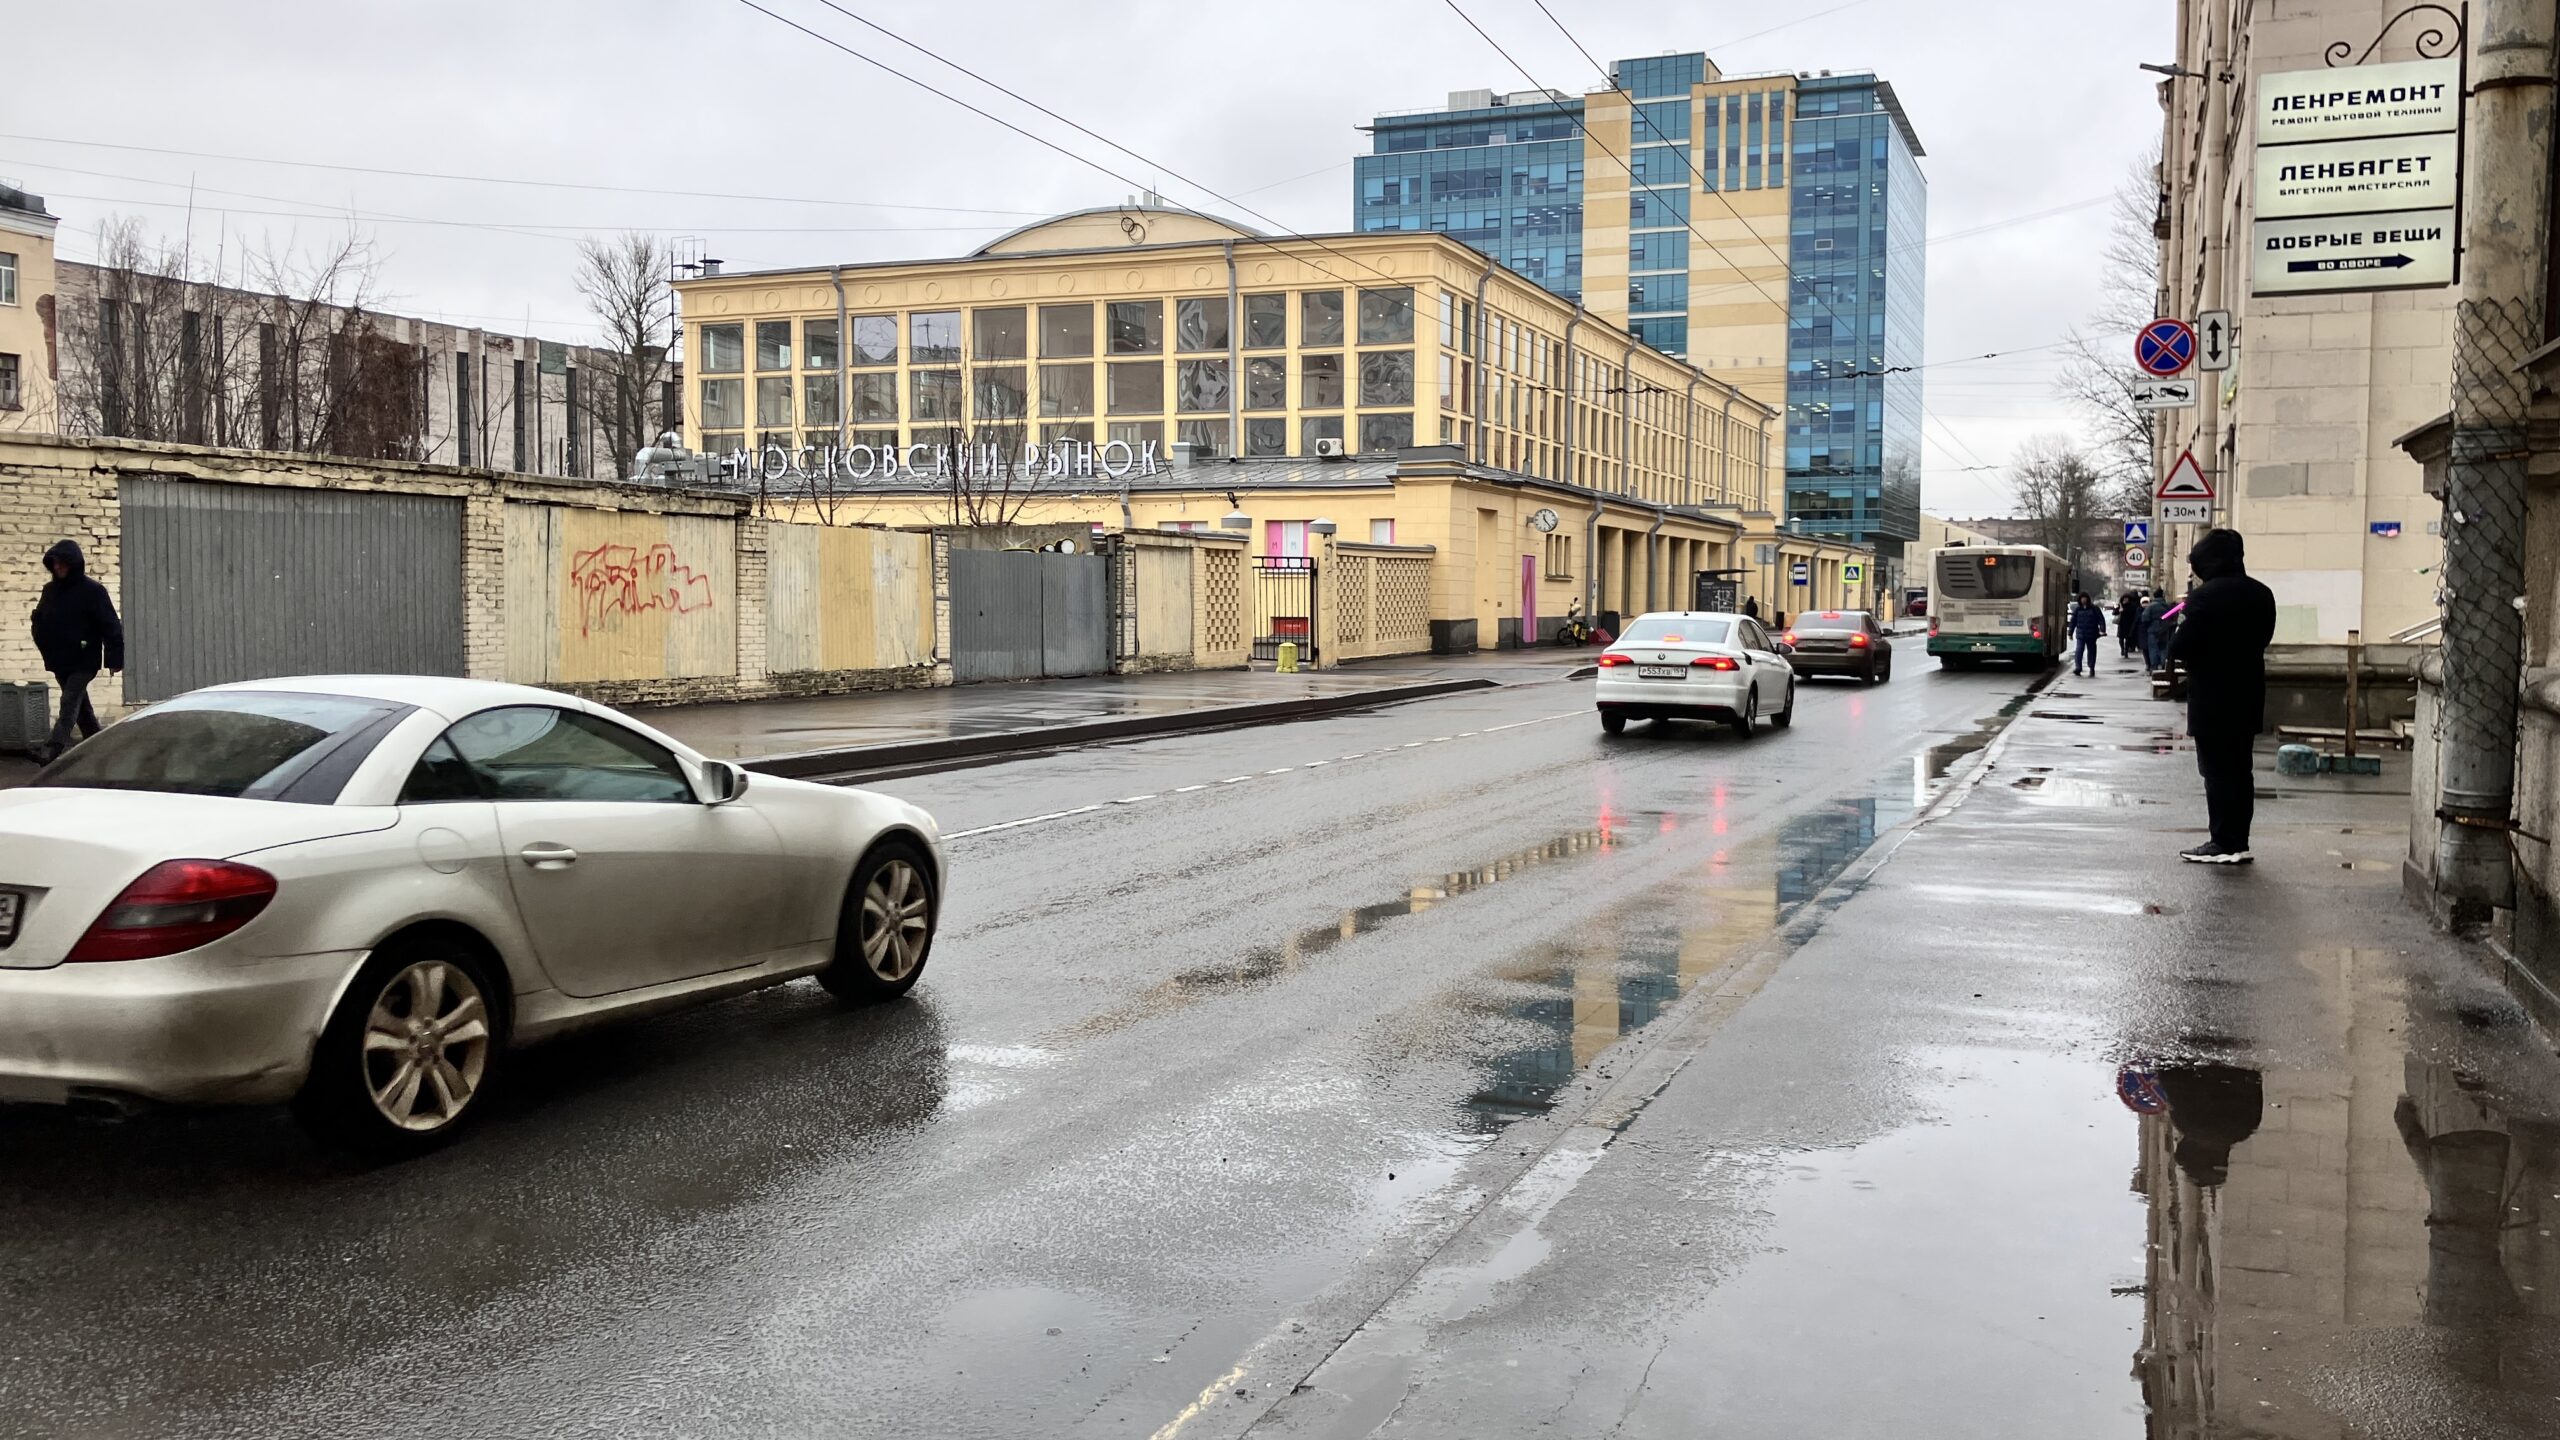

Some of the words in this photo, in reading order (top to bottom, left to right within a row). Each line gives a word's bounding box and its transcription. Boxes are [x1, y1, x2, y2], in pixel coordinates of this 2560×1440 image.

[2272, 84, 2445, 111] ЛЕНРЕМОНТ
[2272, 116, 2319, 126] РЕМОНТ
[2324, 111, 2381, 121] БЫТОВОЙ
[2387, 106, 2442, 117] ТЕХНИКИ
[2279, 156, 2431, 181] ЛЕНБАГЕТ
[2279, 185, 2342, 196] БАГЕТНАЯ
[2347, 179, 2430, 191] МАСТЕРСКАЯ
[2266, 232, 2362, 250] ДОБРЫЕ
[2373, 227, 2441, 244] ВЕЩИ
[2317, 261, 2334, 270] ВО
[2339, 258, 2382, 269] ДВОРЕ
[733, 431, 998, 480] МОСКОВСКИЙ
[1025, 440, 1158, 477] РЫНОК
[1984, 557, 1997, 566] 12
[2129, 552, 2143, 561] 40
